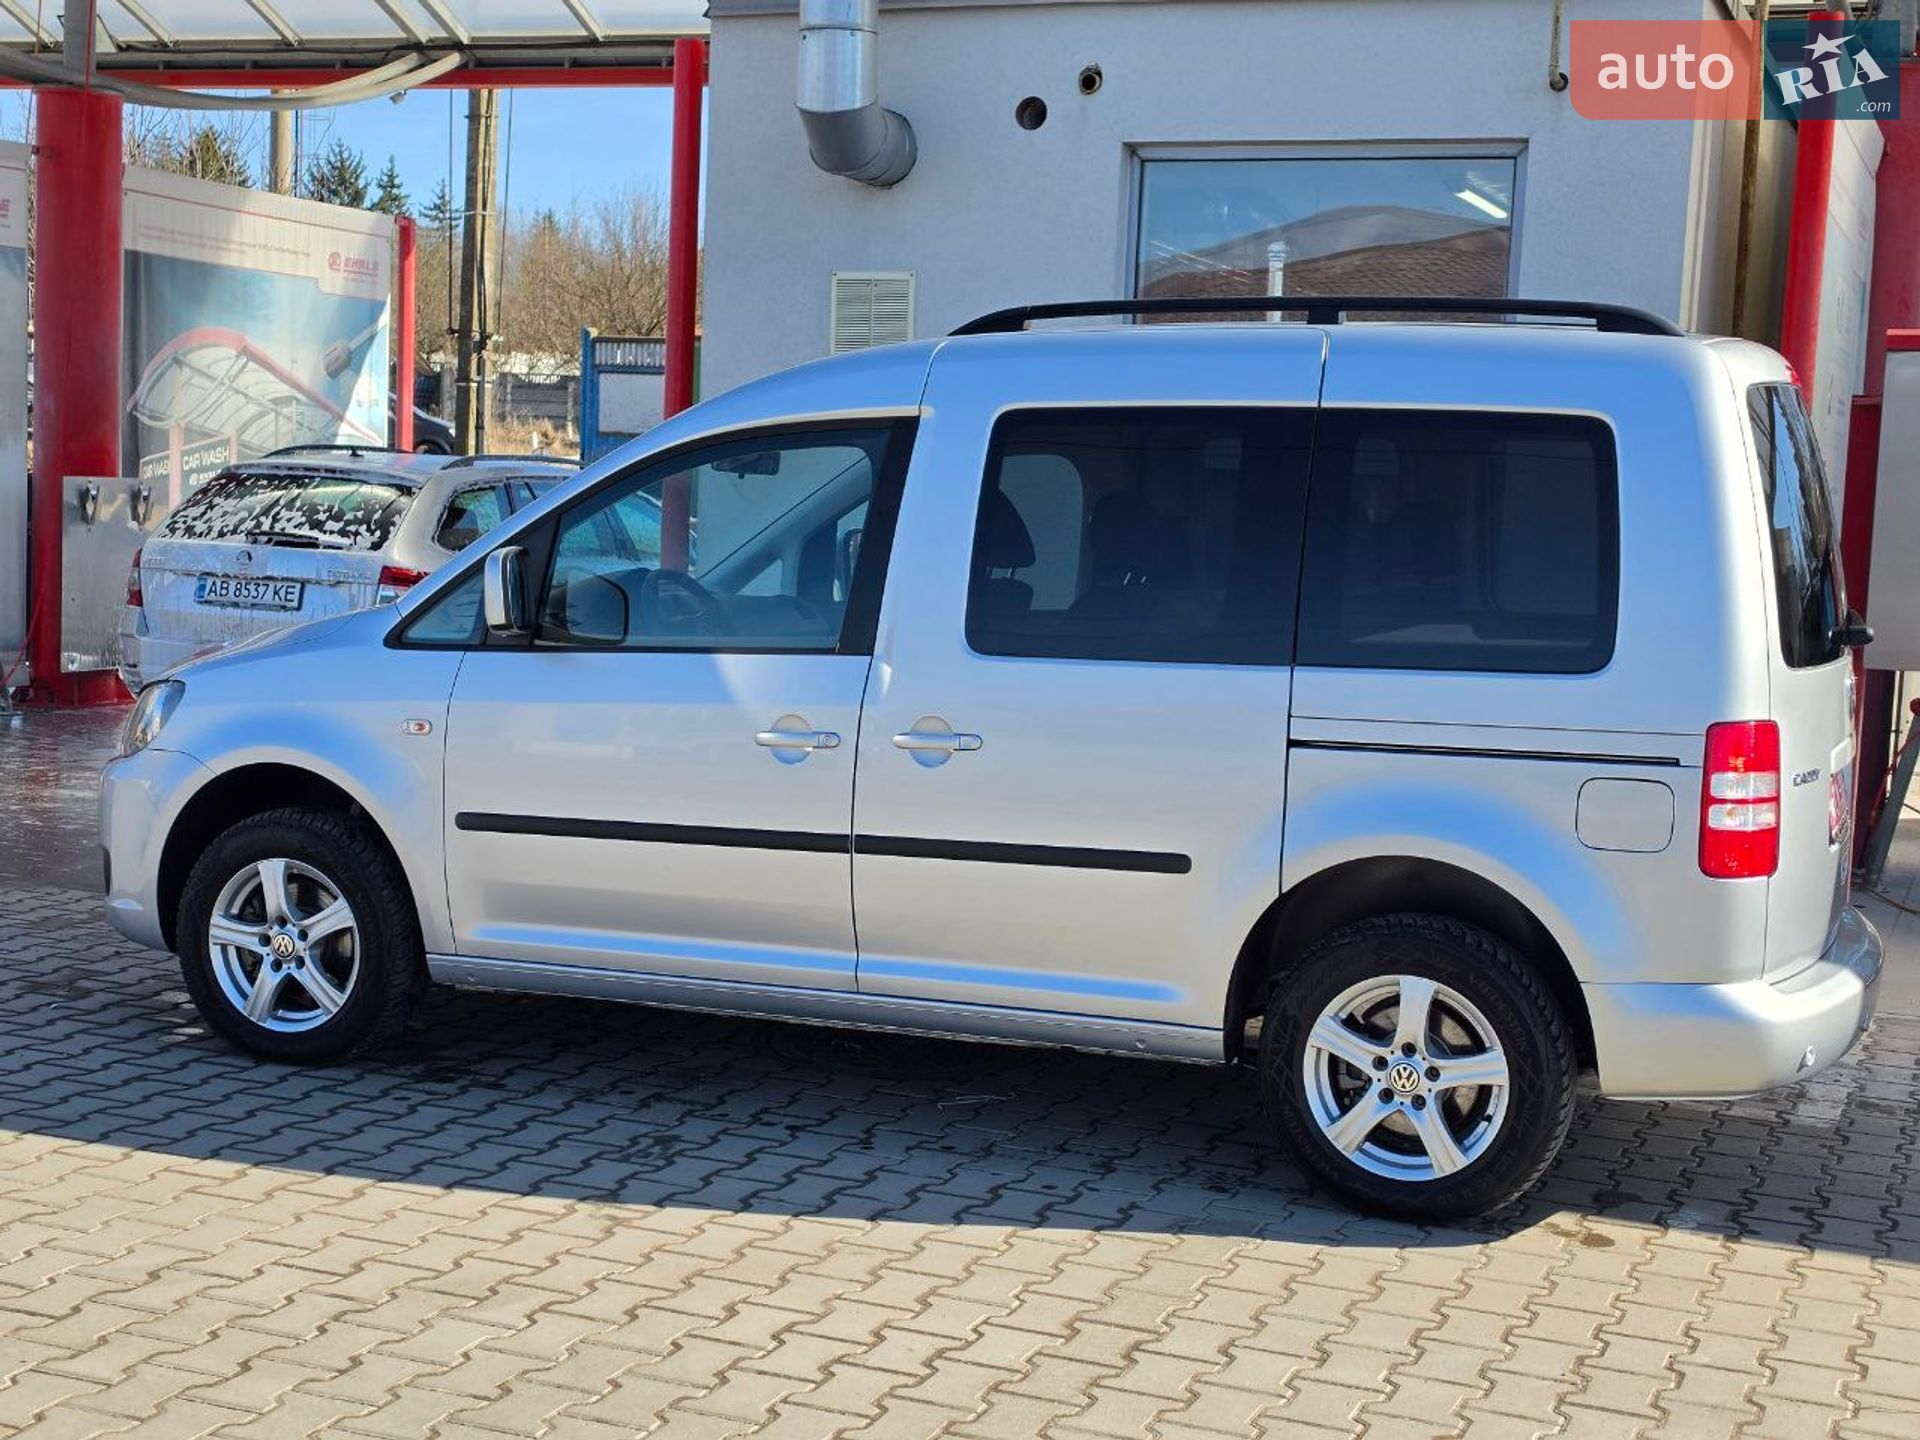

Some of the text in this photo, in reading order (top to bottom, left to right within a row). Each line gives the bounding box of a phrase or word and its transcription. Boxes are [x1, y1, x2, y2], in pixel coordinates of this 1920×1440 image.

[182, 445, 229, 471] CAR WASH
[207, 580, 297, 602] AB 8537 KE
